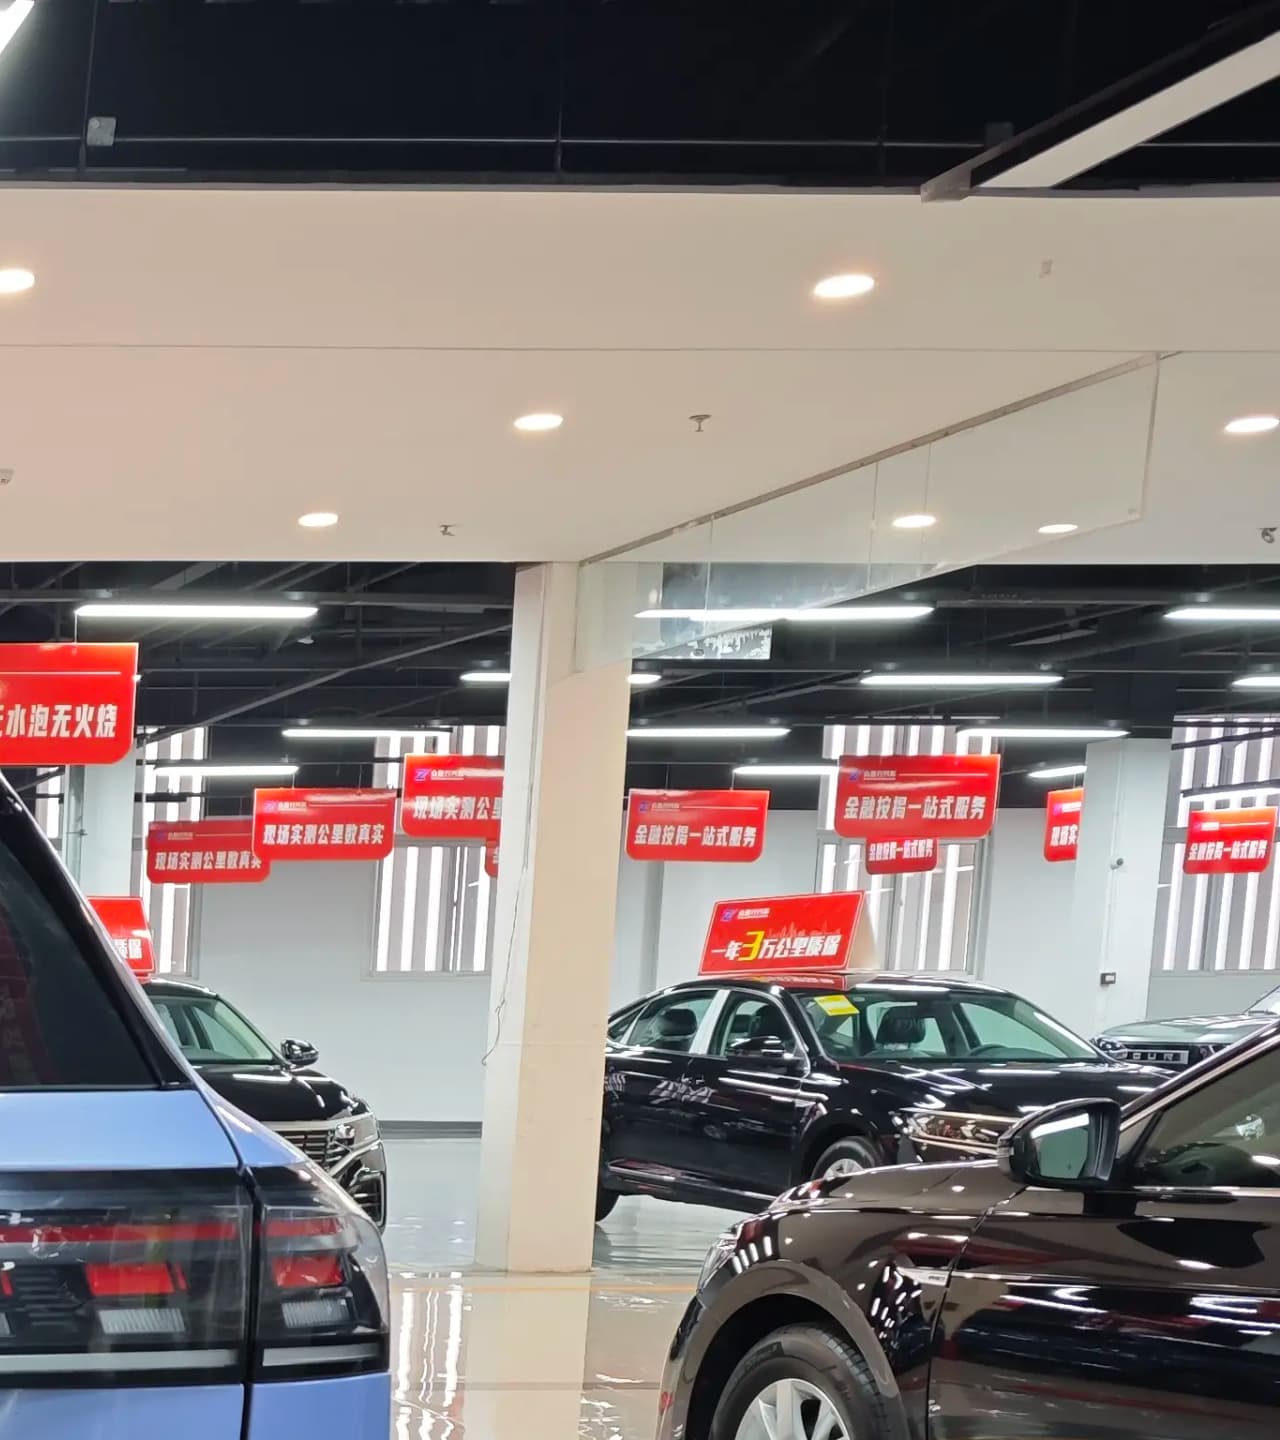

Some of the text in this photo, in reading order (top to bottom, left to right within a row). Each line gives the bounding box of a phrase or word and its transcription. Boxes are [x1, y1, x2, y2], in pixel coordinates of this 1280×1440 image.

[843, 796, 987, 820] 金融按揭一站式服务
[262, 824, 385, 845] 现场实测公里数真实
[633, 824, 758, 848] 金融按揭一站式服务
